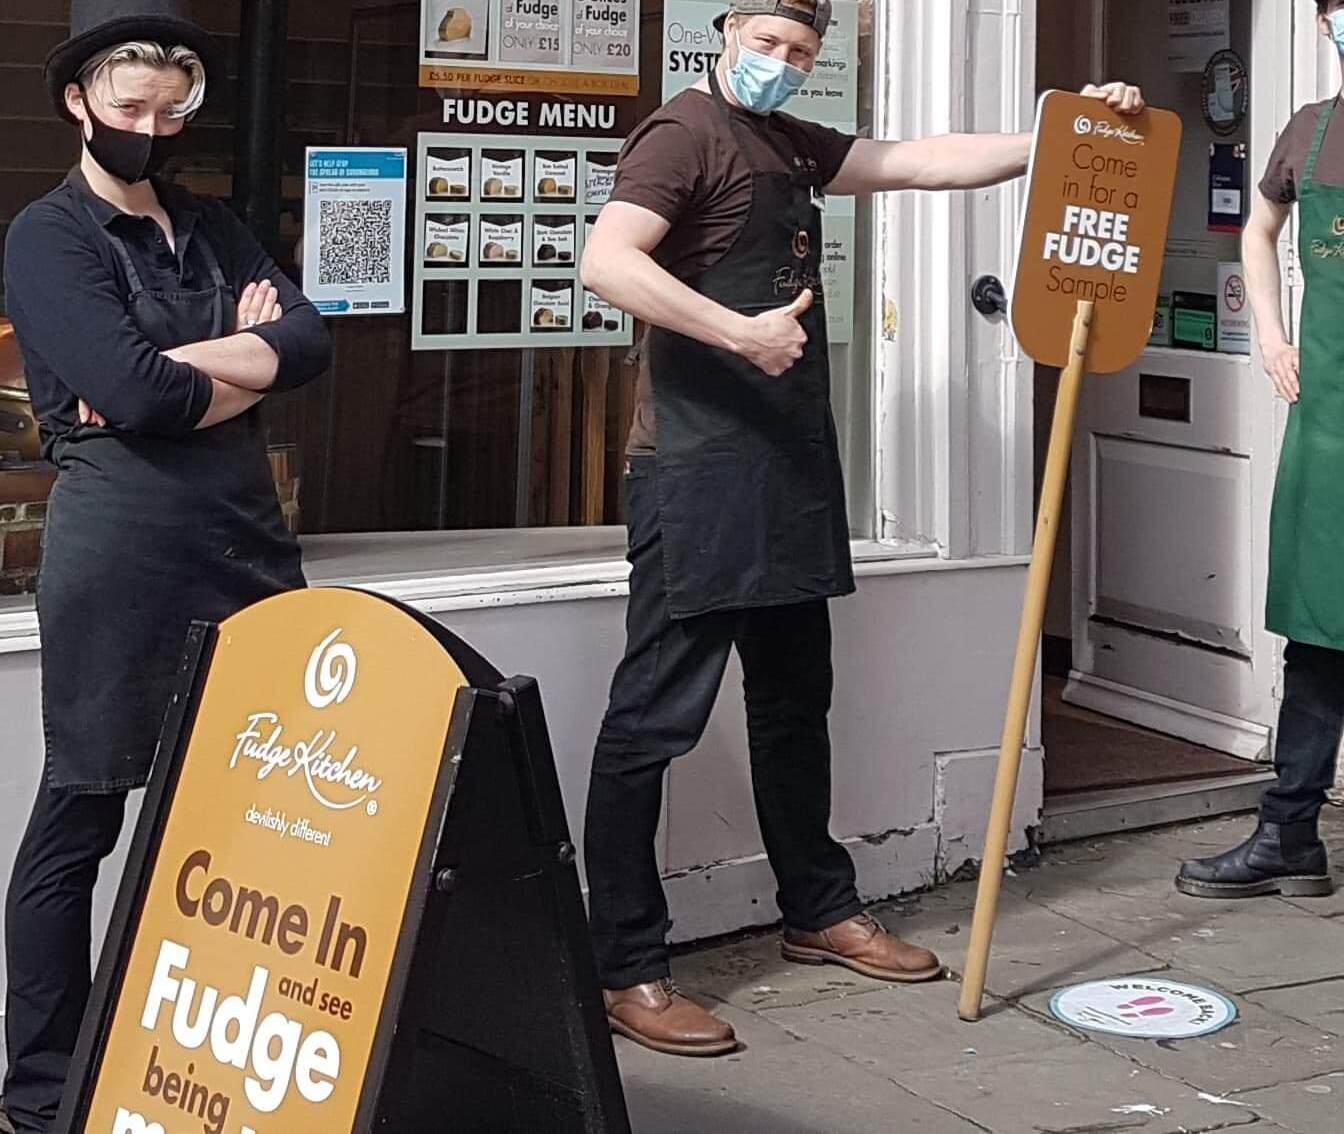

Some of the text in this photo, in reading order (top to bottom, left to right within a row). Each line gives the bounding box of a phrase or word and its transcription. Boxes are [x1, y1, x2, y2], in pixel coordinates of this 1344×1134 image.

[585, 5, 627, 26] Fudge
[668, 22, 724, 44] One-W
[538, 37, 560, 51] £15
[607, 43, 631, 57] £20
[669, 50, 722, 73] SYST
[474, 74, 501, 84] FUDGE
[443, 98, 616, 129] FUDGE MENU
[1072, 143, 1138, 178] Come
[1062, 174, 1138, 209] in for a
[1063, 205, 1129, 241] FREE
[1043, 232, 1141, 274] FUDGE
[1046, 265, 1127, 303] Sample
[229, 712, 382, 809] Fudge Kitchen
[245, 802, 332, 847] devilishly different
[175, 849, 368, 979] Come In
[278, 976, 353, 1021] and see
[1108, 983, 1207, 1004] WELCOME
[140, 938, 341, 1113] Fudge
[141, 1045, 231, 1134] being
